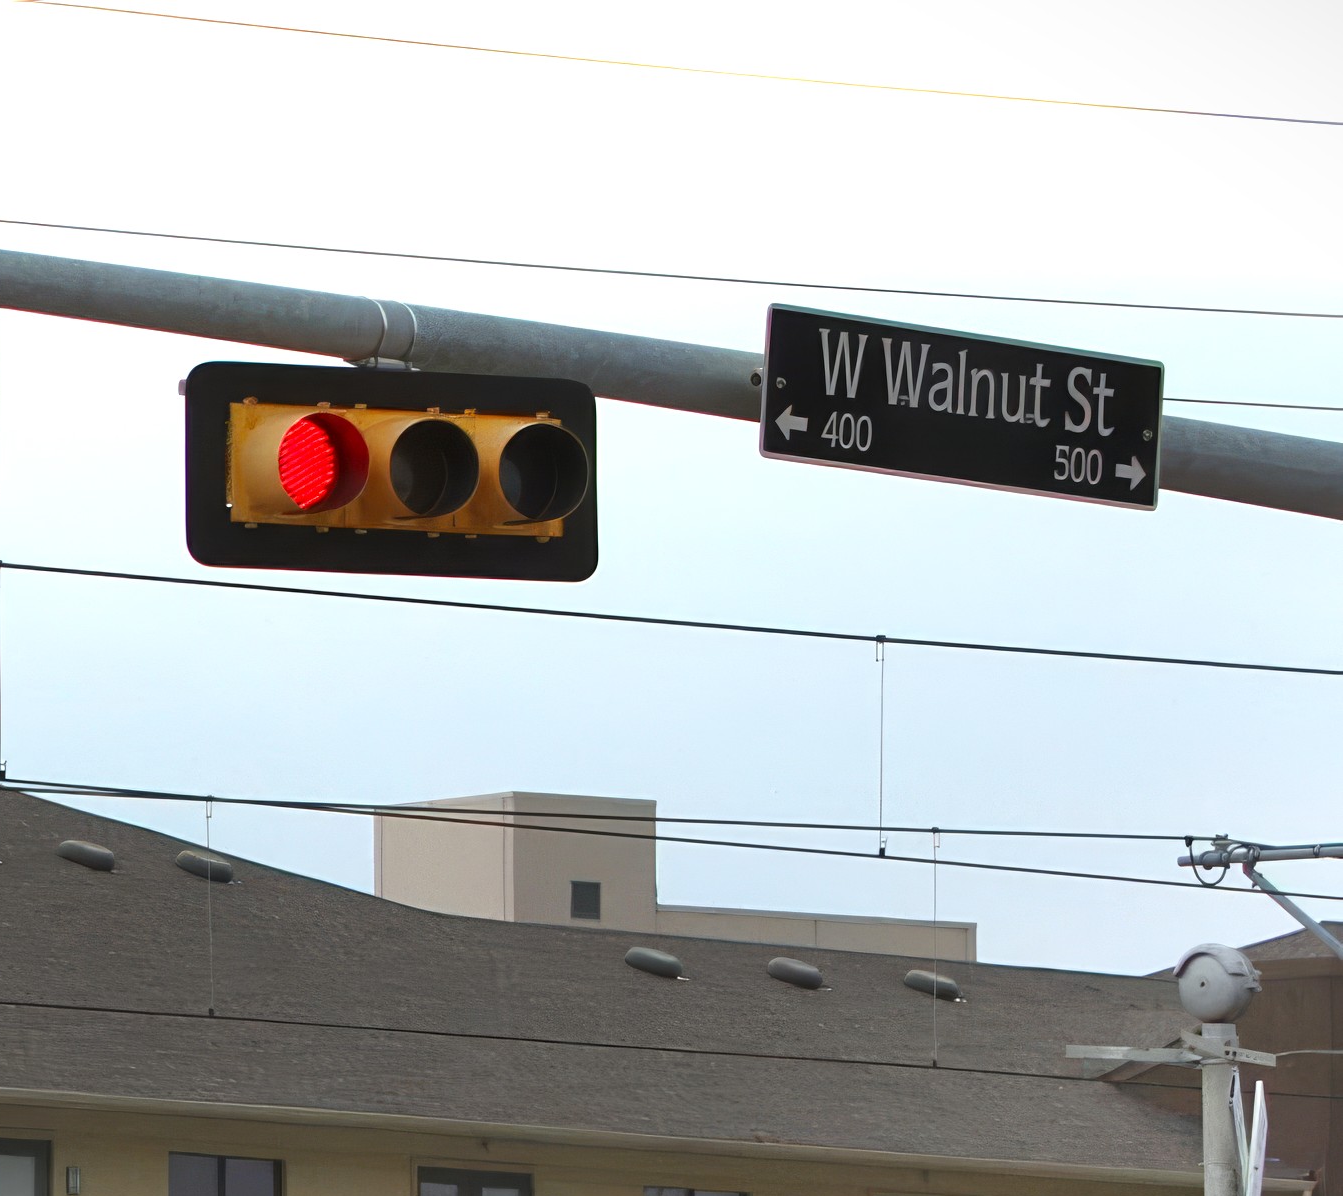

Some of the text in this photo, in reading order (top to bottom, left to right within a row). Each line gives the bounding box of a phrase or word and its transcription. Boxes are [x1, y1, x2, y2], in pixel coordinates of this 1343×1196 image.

[818, 328, 1115, 437] W Walnut St
[820, 411, 873, 452] 400
[1053, 444, 1103, 485] 500
